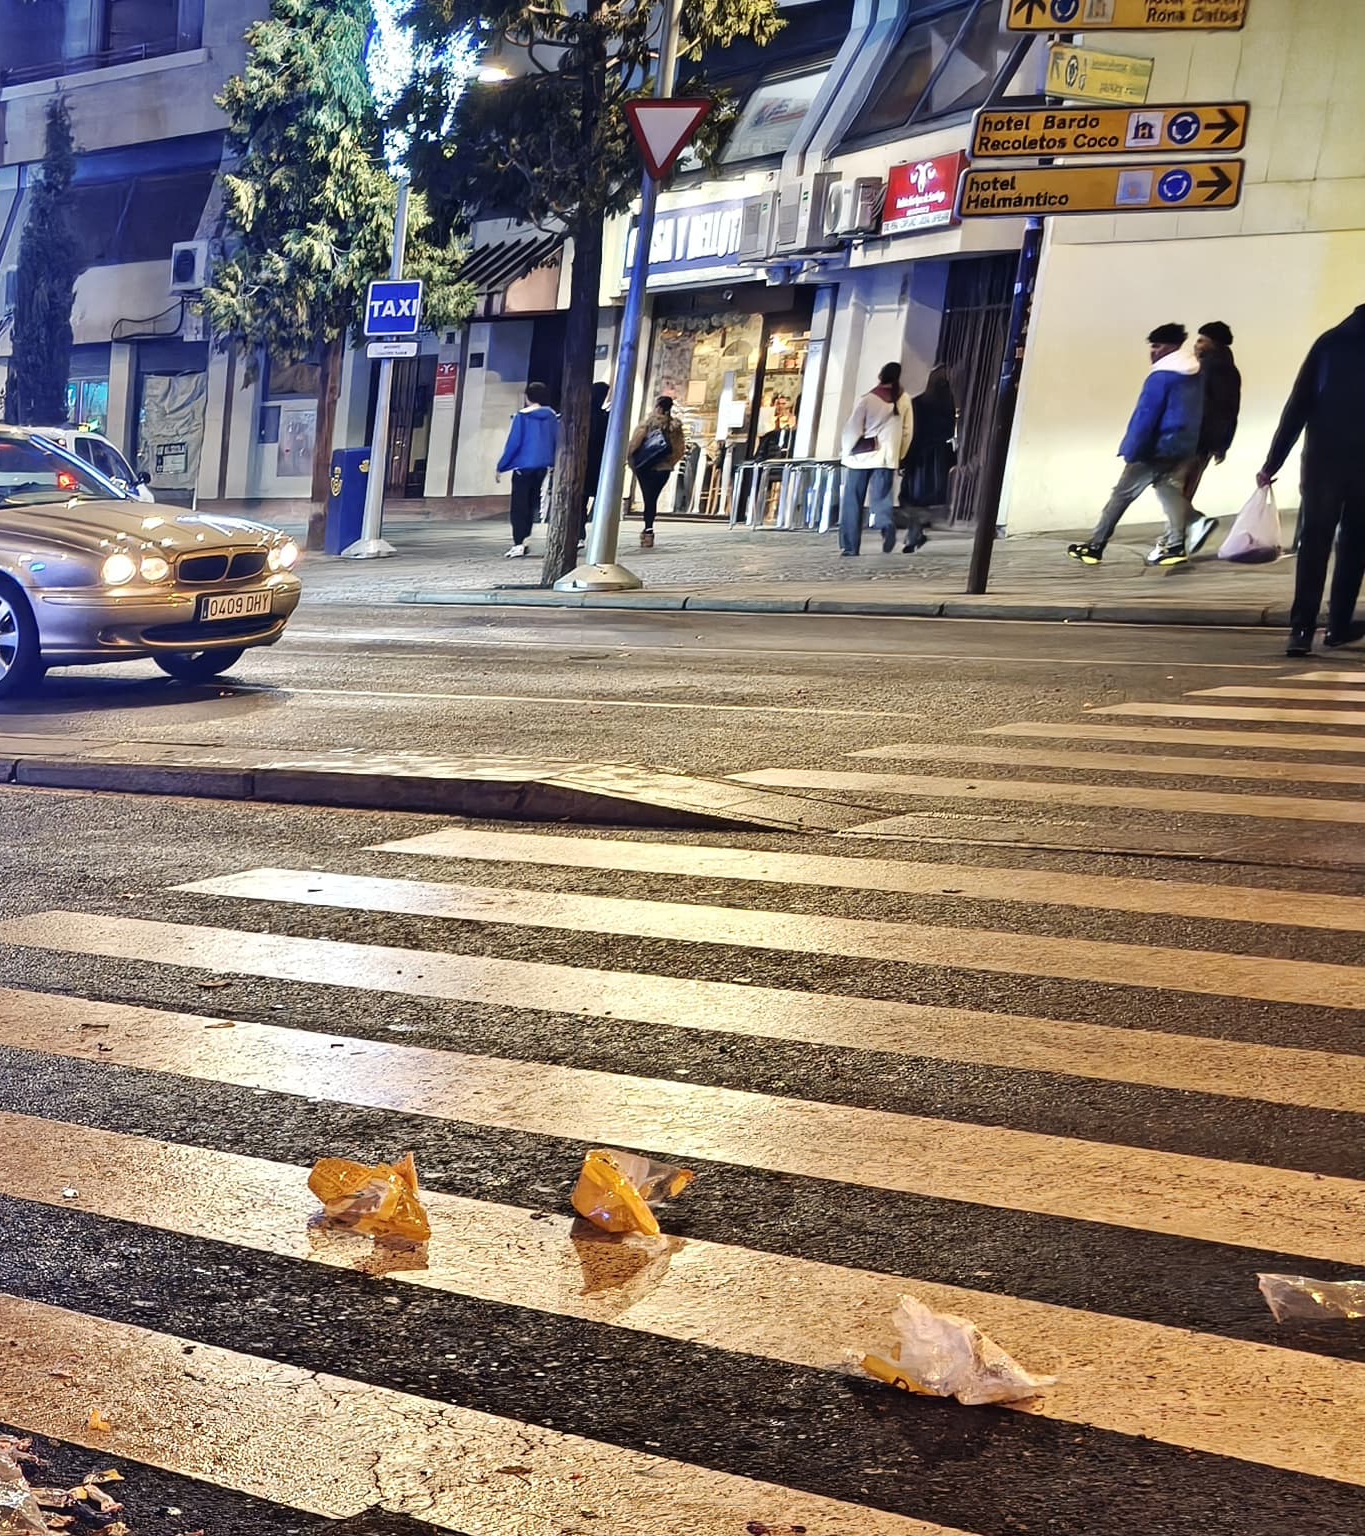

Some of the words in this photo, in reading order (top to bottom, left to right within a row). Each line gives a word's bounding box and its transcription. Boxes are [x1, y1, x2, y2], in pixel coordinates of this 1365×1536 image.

[1145, 8, 1186, 23] Rona
[981, 115, 1030, 132] hotel
[1043, 115, 1100, 130] Bardo
[977, 133, 1067, 151] Recoletos
[1073, 133, 1119, 149] Coco
[969, 176, 1017, 193] hotel
[370, 298, 419, 318] TAXI
[209, 597, 243, 617] 0409
[245, 593, 270, 613] DHY
